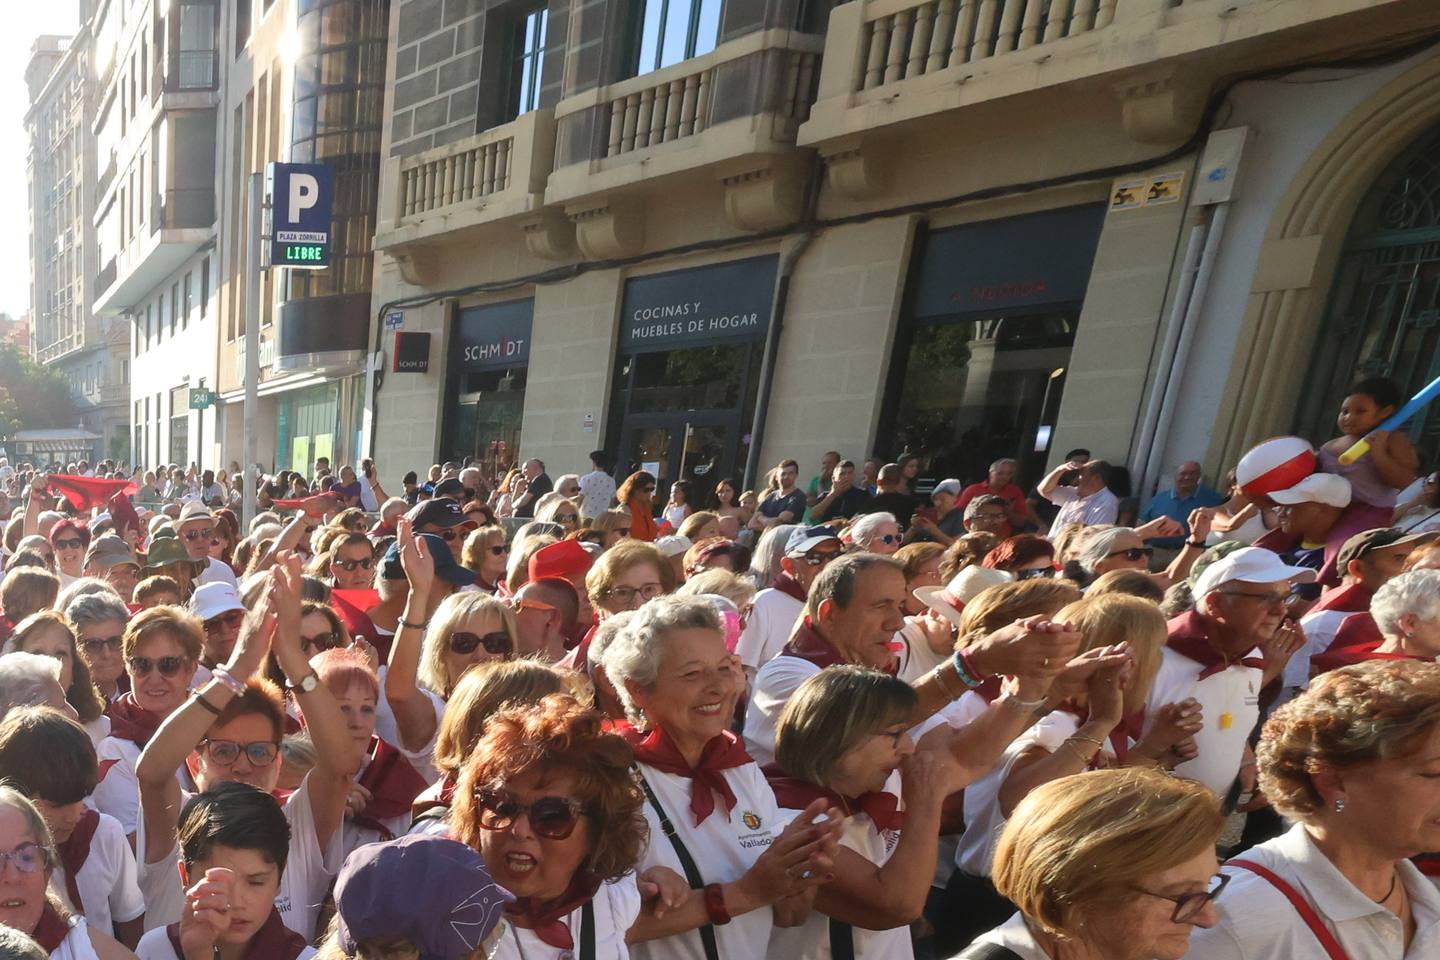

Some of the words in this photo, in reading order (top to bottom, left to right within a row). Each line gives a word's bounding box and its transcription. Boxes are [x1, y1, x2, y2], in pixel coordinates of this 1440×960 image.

[288, 173, 319, 223] P
[279, 232, 297, 240] PLAZA
[298, 233, 324, 241] ZORRILLA
[286, 246, 322, 260] LIBRE
[633, 303, 689, 320] COCINAS
[694, 302, 701, 313] Y
[631, 322, 683, 339] MUEBLES
[687, 319, 704, 332] DE
[708, 313, 758, 330] HOGAR
[399, 360, 428, 368] SCHMDT
